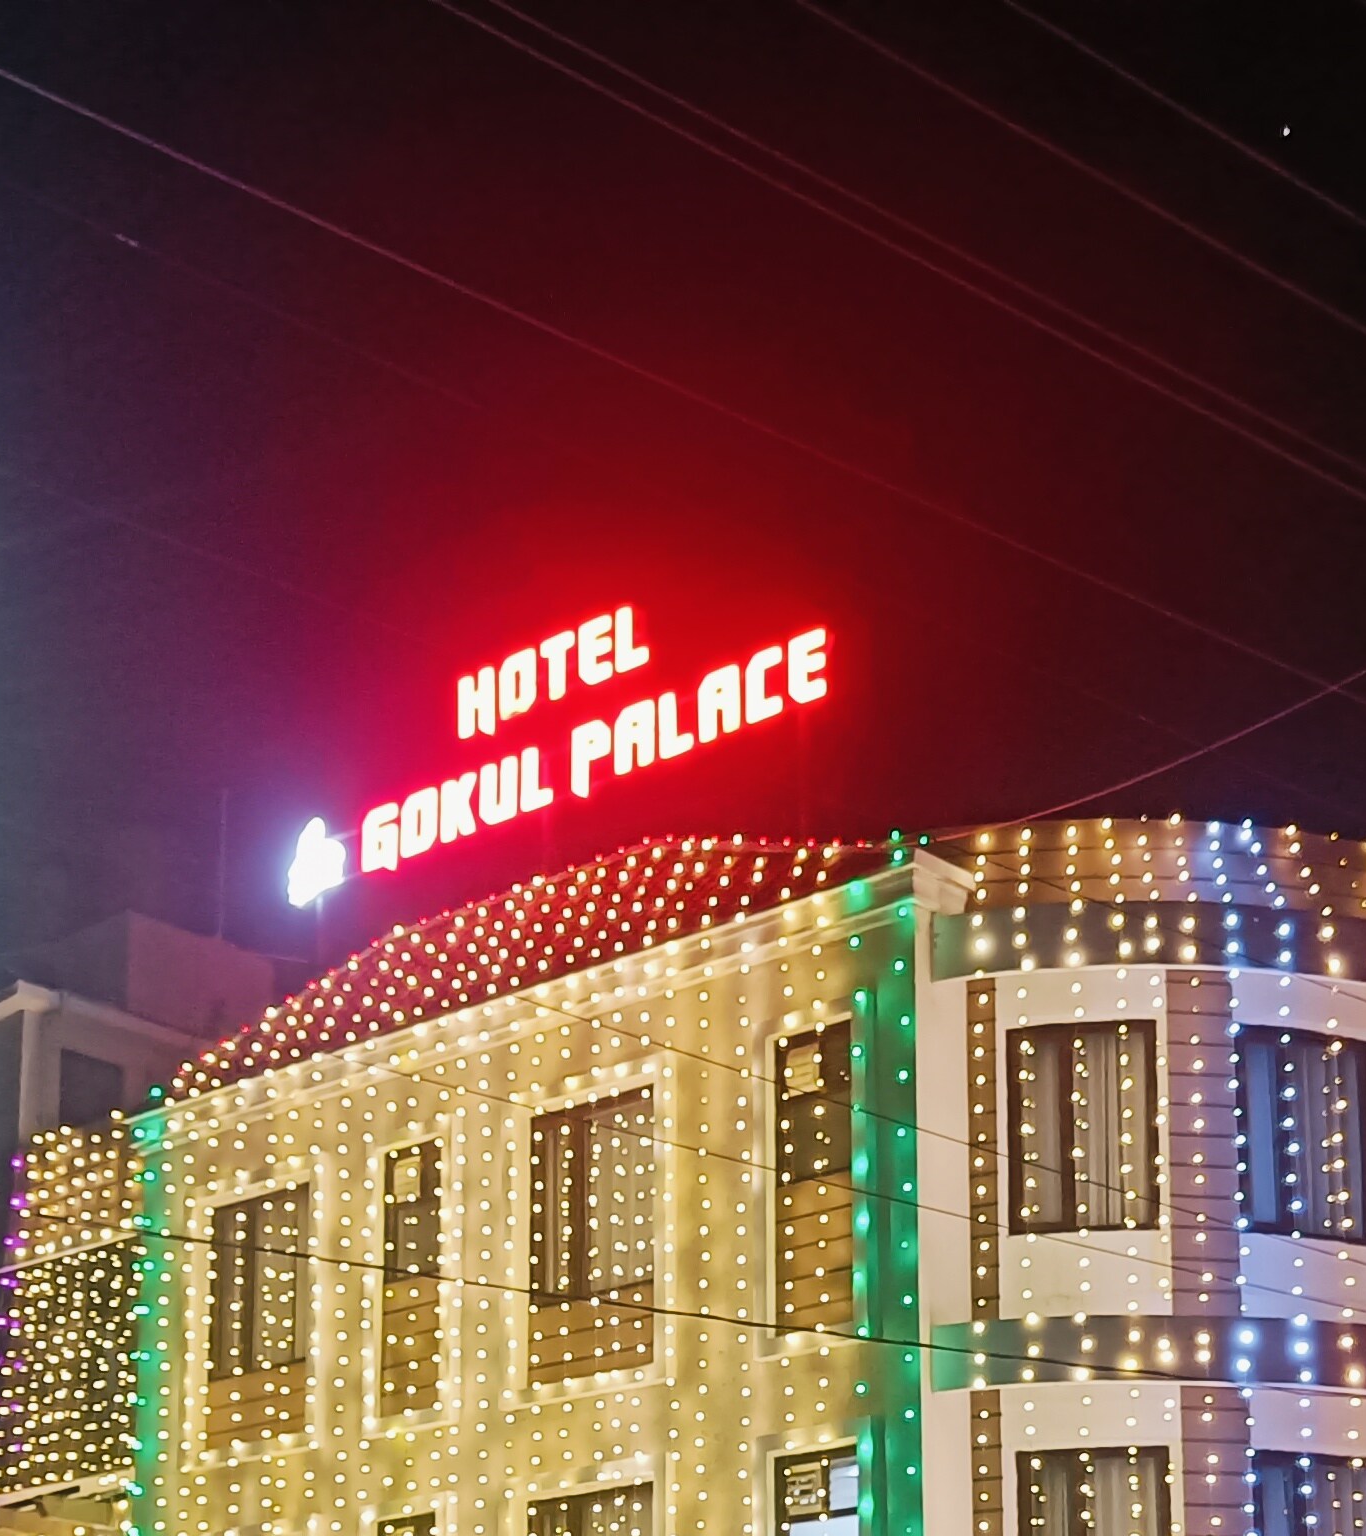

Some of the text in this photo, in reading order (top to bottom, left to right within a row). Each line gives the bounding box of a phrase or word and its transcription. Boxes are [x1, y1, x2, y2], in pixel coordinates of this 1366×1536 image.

[359, 627, 828, 874] GOKUL PALACE
[456, 605, 651, 741] HOTEL
